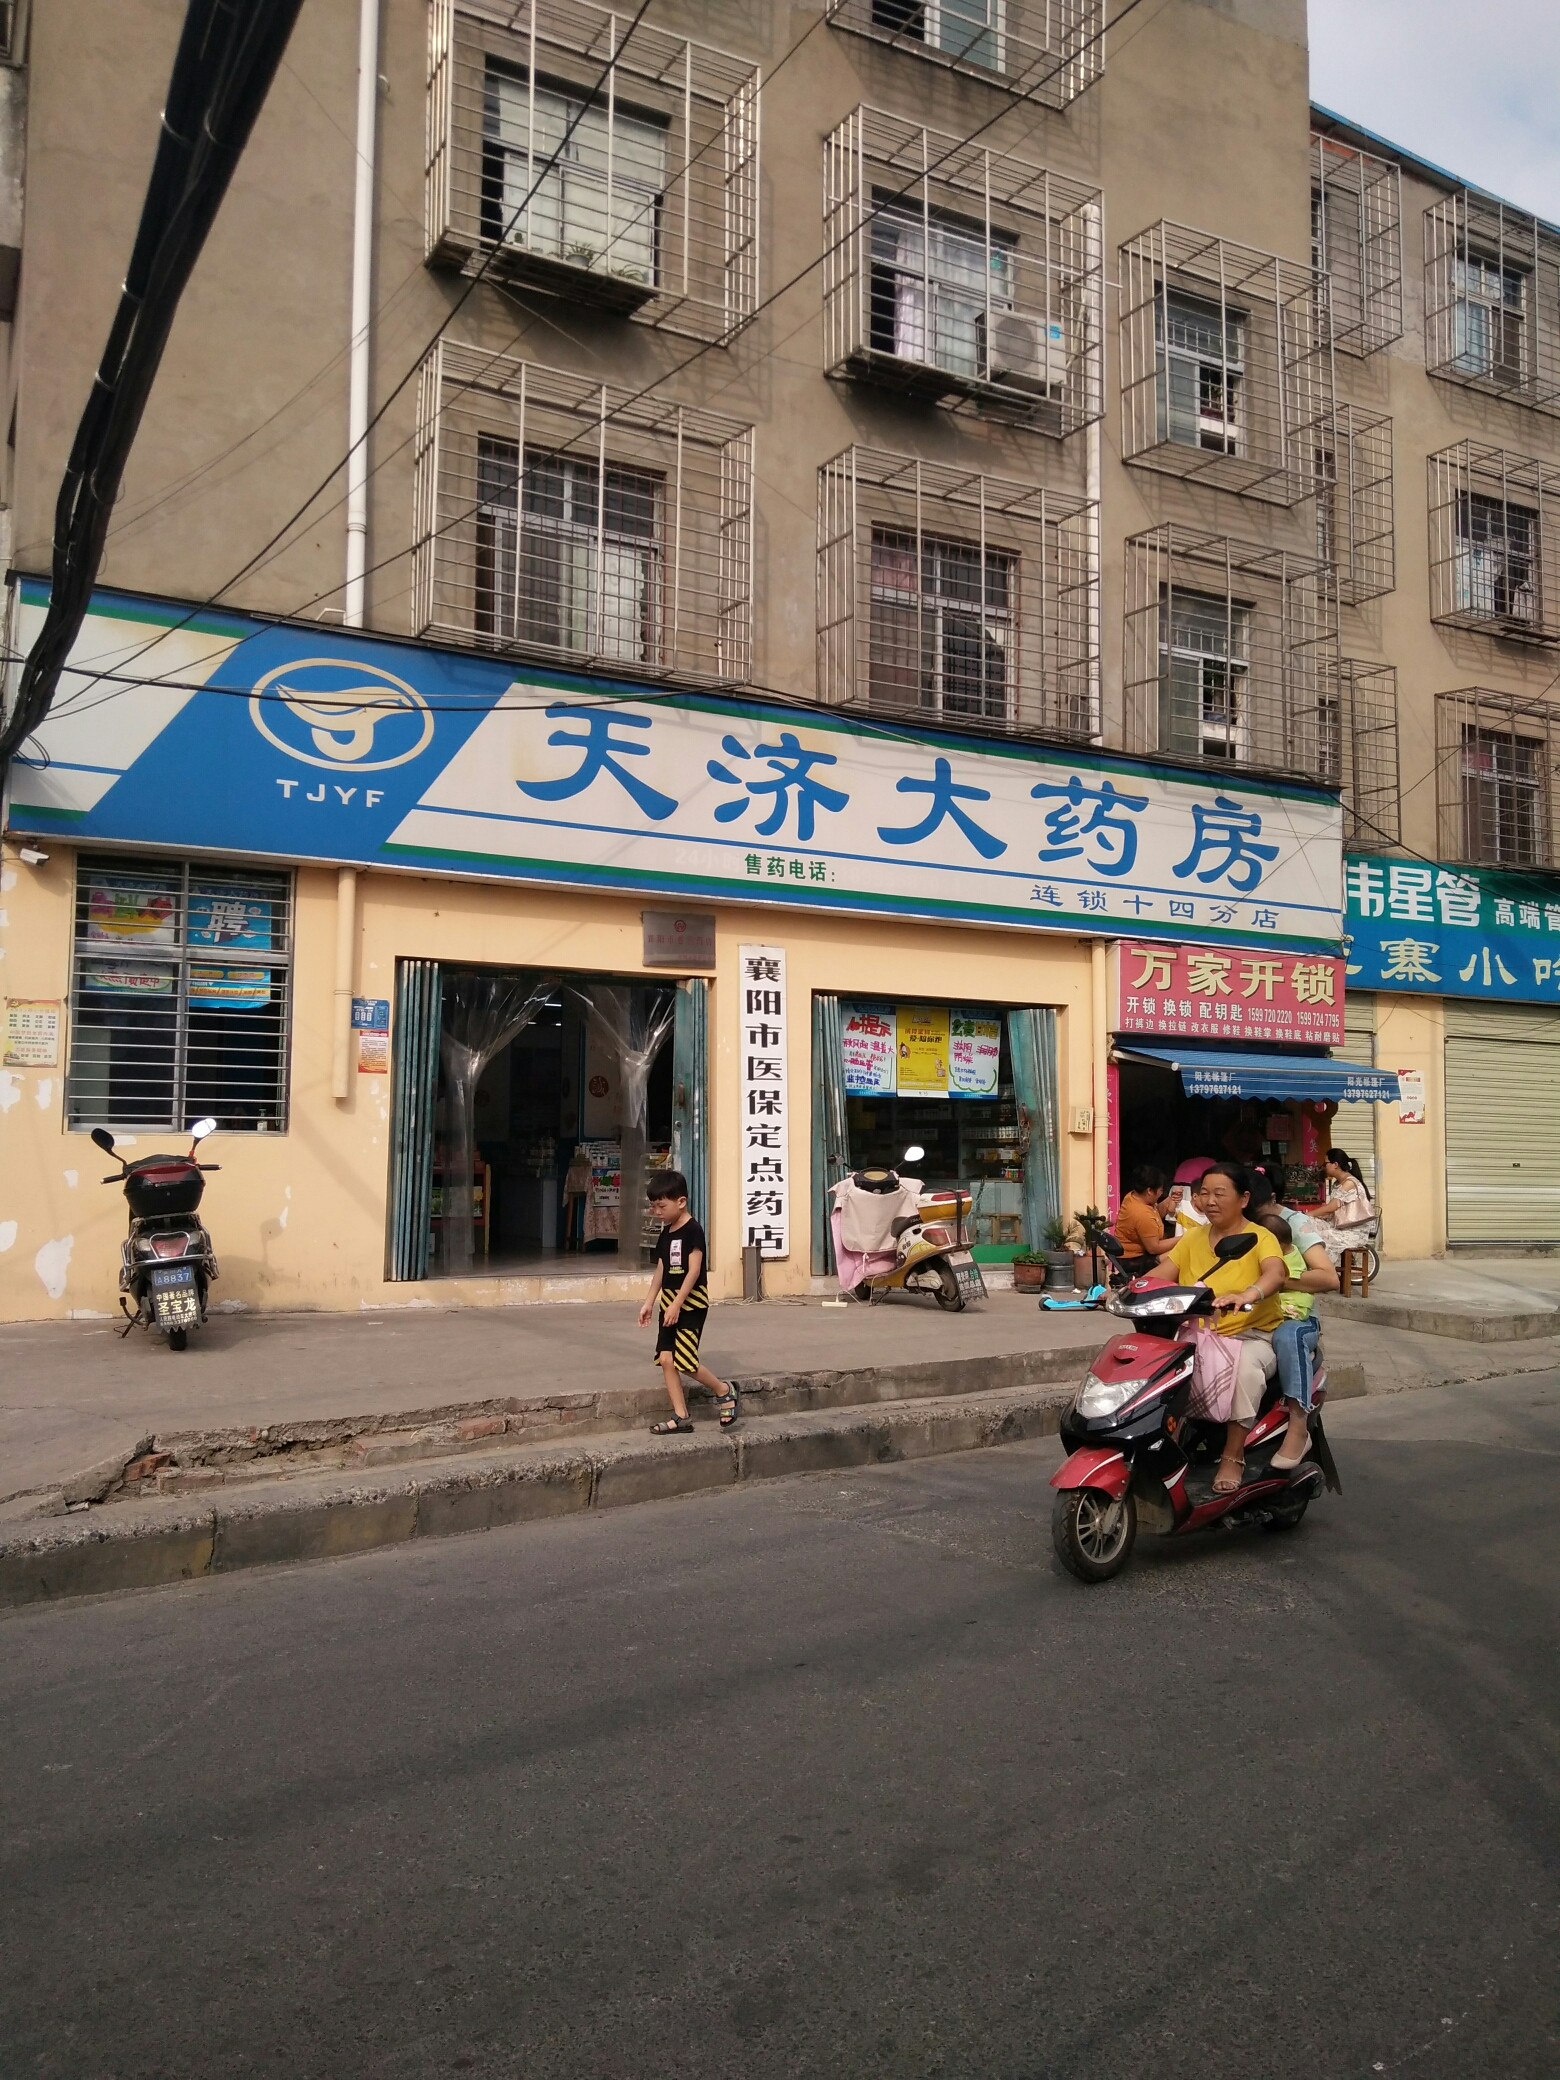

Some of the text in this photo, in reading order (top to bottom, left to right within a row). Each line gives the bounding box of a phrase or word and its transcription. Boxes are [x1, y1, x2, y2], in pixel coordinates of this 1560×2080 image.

[275, 778, 387, 808] TJYF
[515, 701, 1280, 892] 天济大药房
[1029, 883, 1281, 932] 连锁十四分店
[1343, 859, 1482, 927] 伟星管
[1130, 947, 1338, 1007] 万家开锁
[1343, 934, 1560, 989] 寨小
[1124, 1016, 1154, 1030] 打裤边
[1158, 1019, 1187, 1032] 换拉链
[1190, 1021, 1219, 1034] 改衣服
[1222, 1023, 1241, 1036] 修鞋
[1244, 1025, 1272, 1038] 换鞋掌
[1275, 1028, 1302, 1041] 换鞋底
[1126, 995, 1156, 1016] 开锁
[1163, 998, 1193, 1018] 换锁
[1199, 1001, 1243, 1022] 配钥匙
[743, 955, 785, 1252] 襄阳市医保定点药店
[1189, 1083, 1242, 1095] 13797627121
[157, 1297, 197, 1316] 圣宝龙
